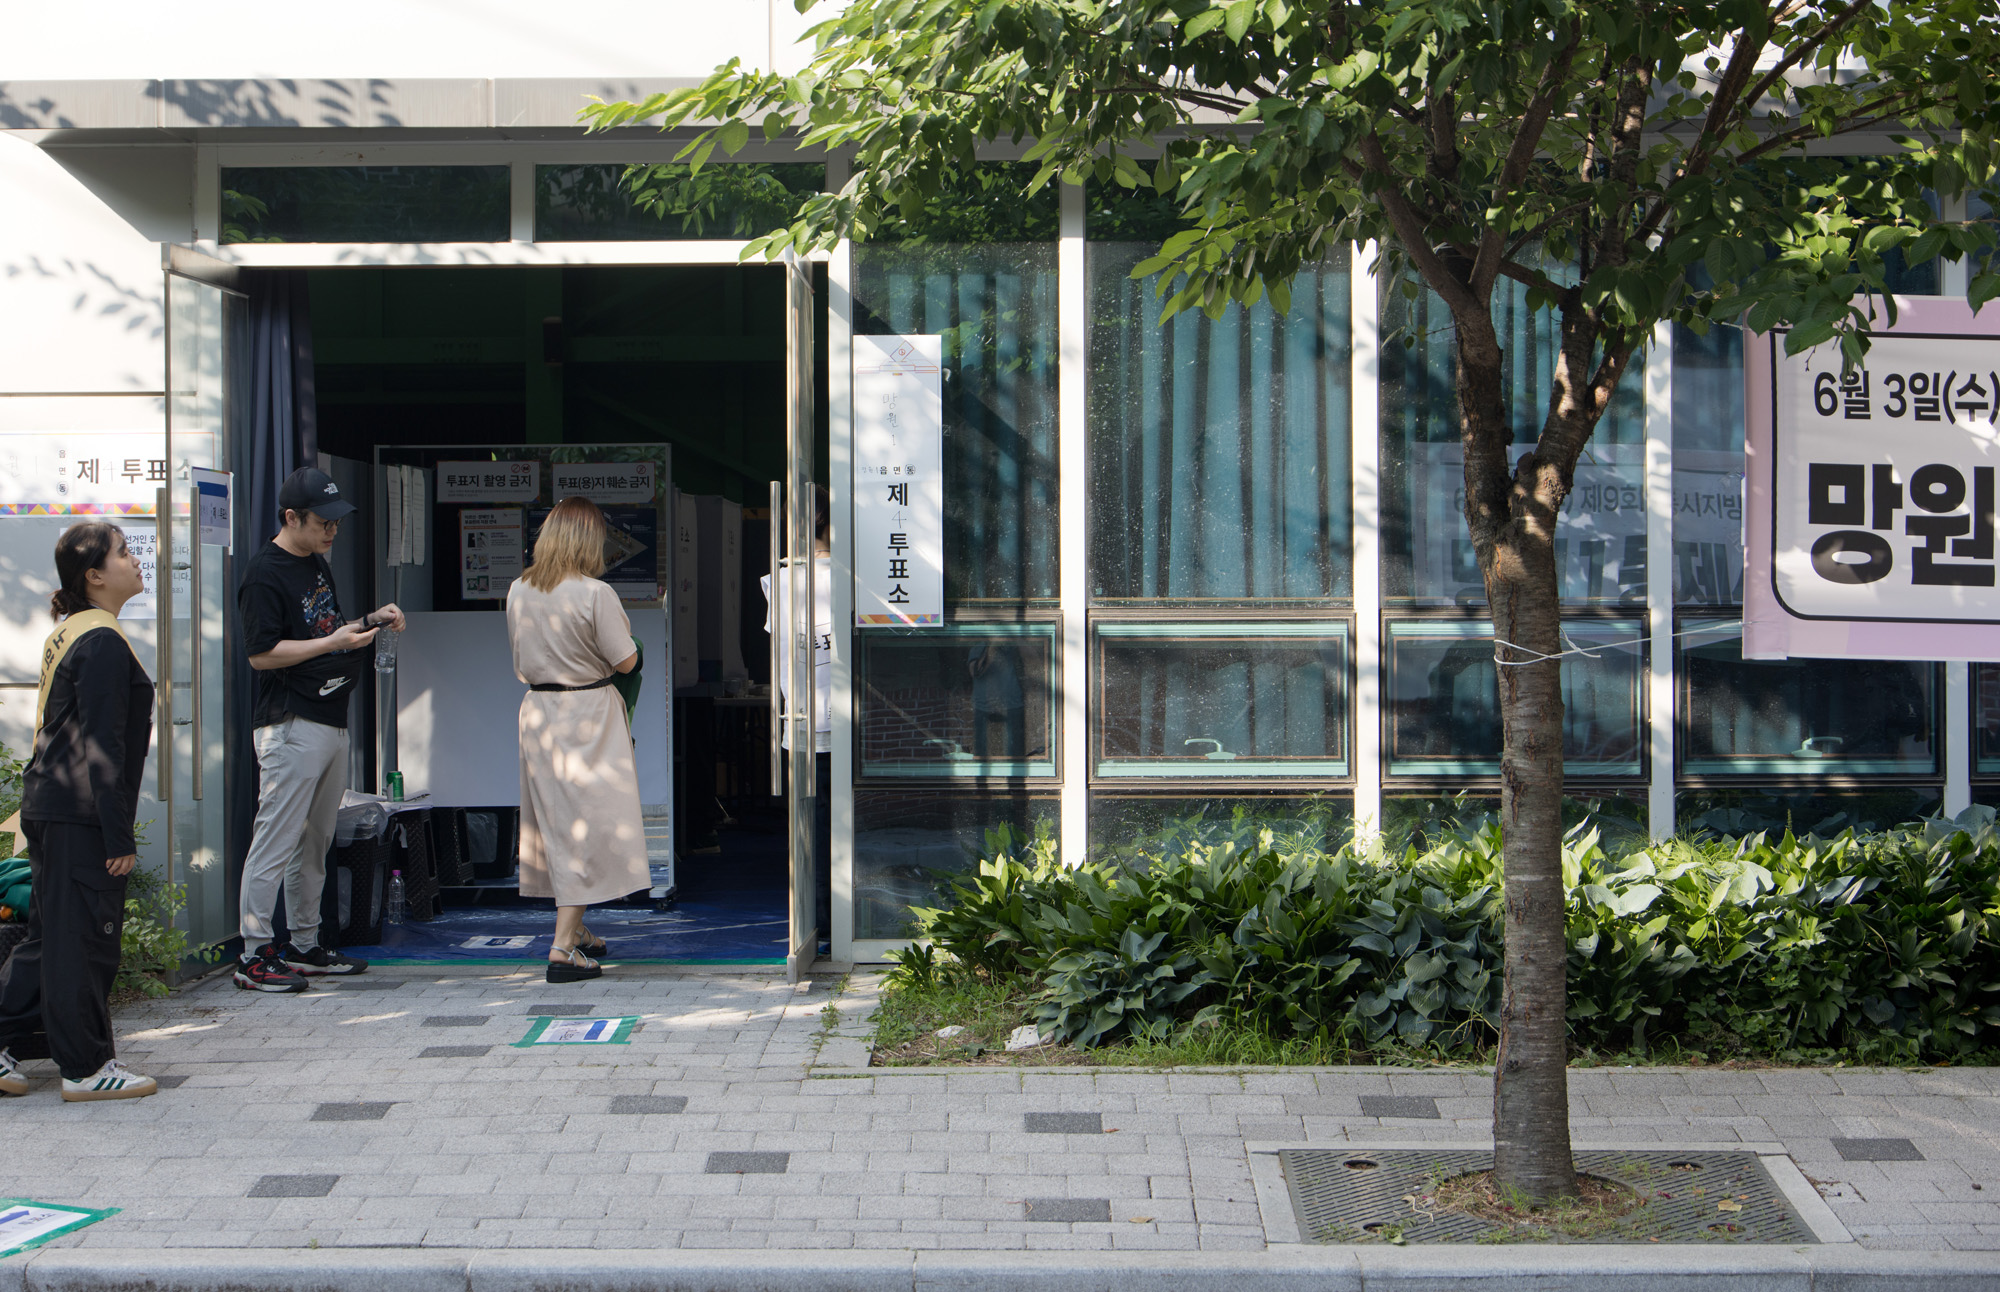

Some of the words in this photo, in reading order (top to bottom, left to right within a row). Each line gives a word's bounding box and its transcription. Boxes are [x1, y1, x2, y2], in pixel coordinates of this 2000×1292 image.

[1814, 370, 1871, 420] 6월
[1883, 370, 2000, 425] 3일(수)
[446, 475, 480, 487] 투표지
[484, 475, 506, 487] 촬영
[509, 475, 531, 487] 금지
[558, 476, 605, 490] 투표(용)지
[606, 476, 628, 489] 훼손
[629, 475, 650, 489] 금지
[1580, 484, 1645, 513] 제9회
[1809, 463, 1995, 587] 망원
[324, 676, 346, 689] NIKE
